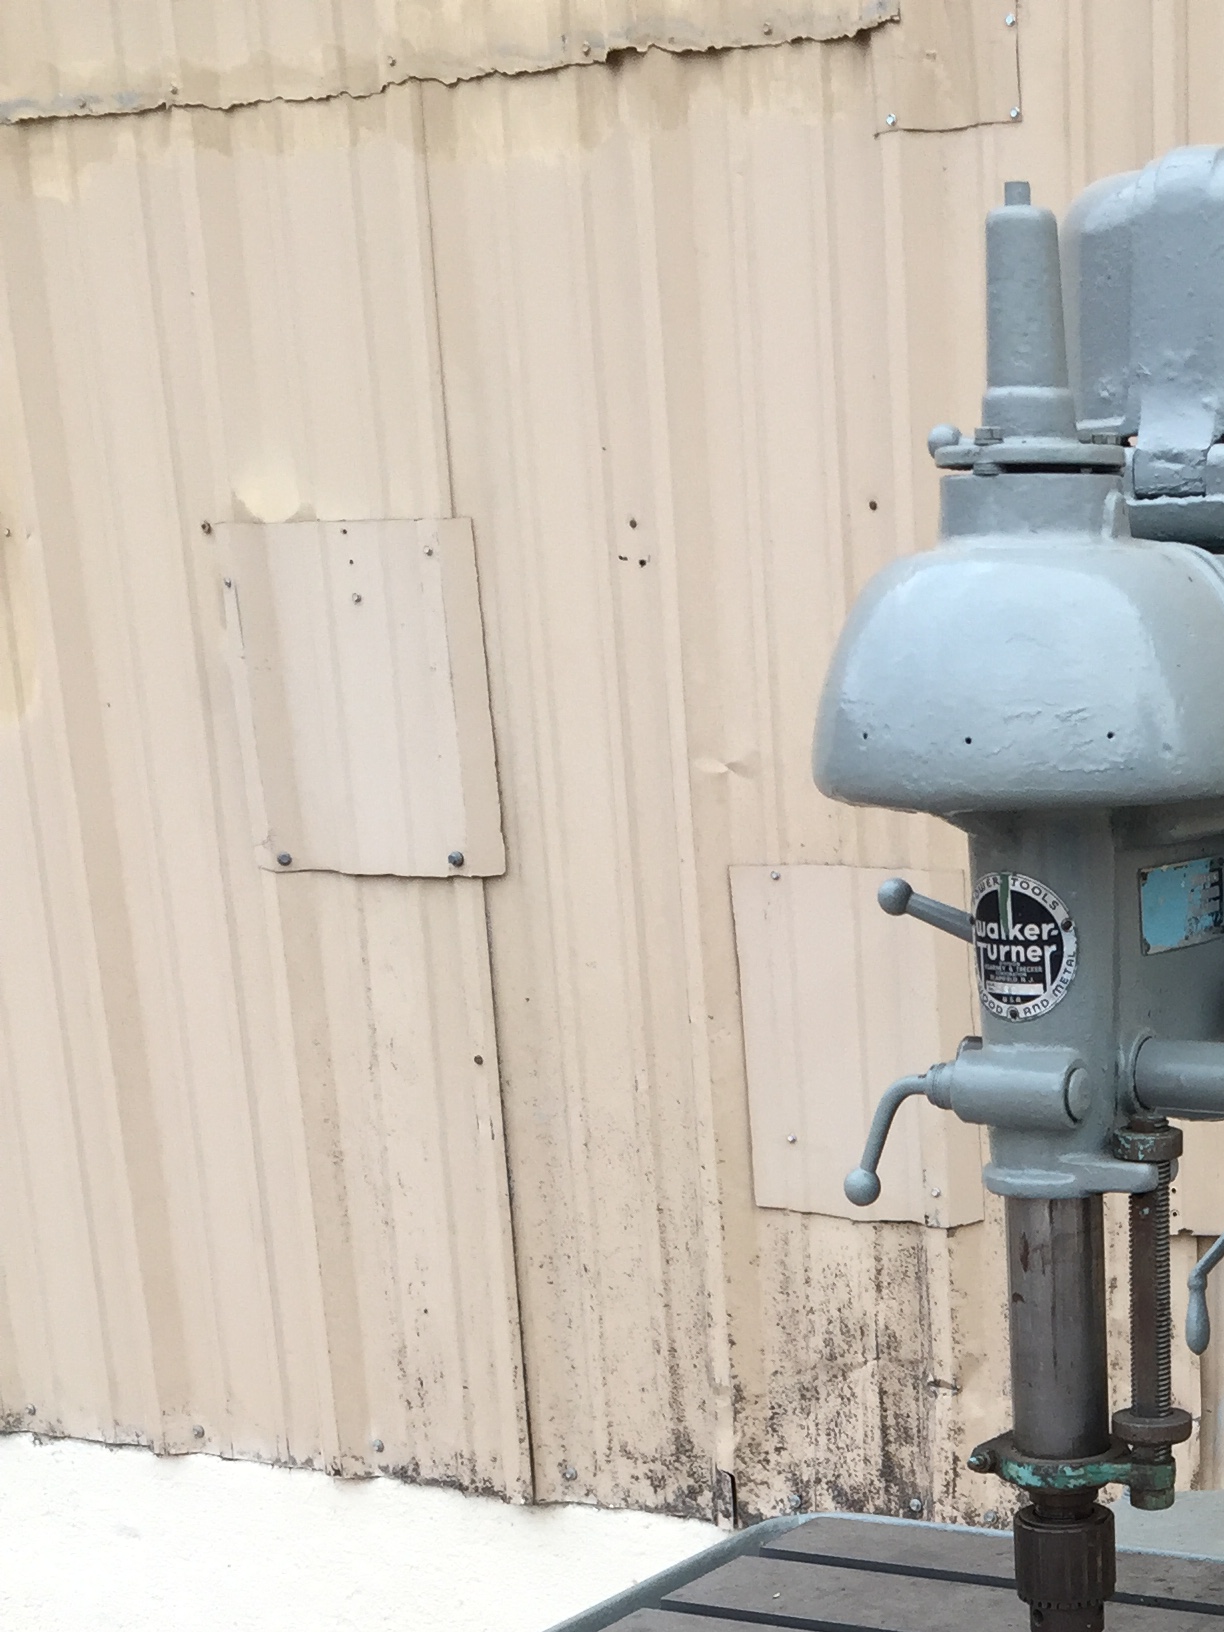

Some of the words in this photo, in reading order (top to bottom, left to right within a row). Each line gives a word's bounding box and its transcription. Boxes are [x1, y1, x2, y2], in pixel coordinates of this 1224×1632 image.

[1011, 877, 1059, 911] TOOLS
[977, 941, 1057, 963] Turner
[1023, 998, 1050, 1016] AND
[1053, 952, 1076, 999] METAL
